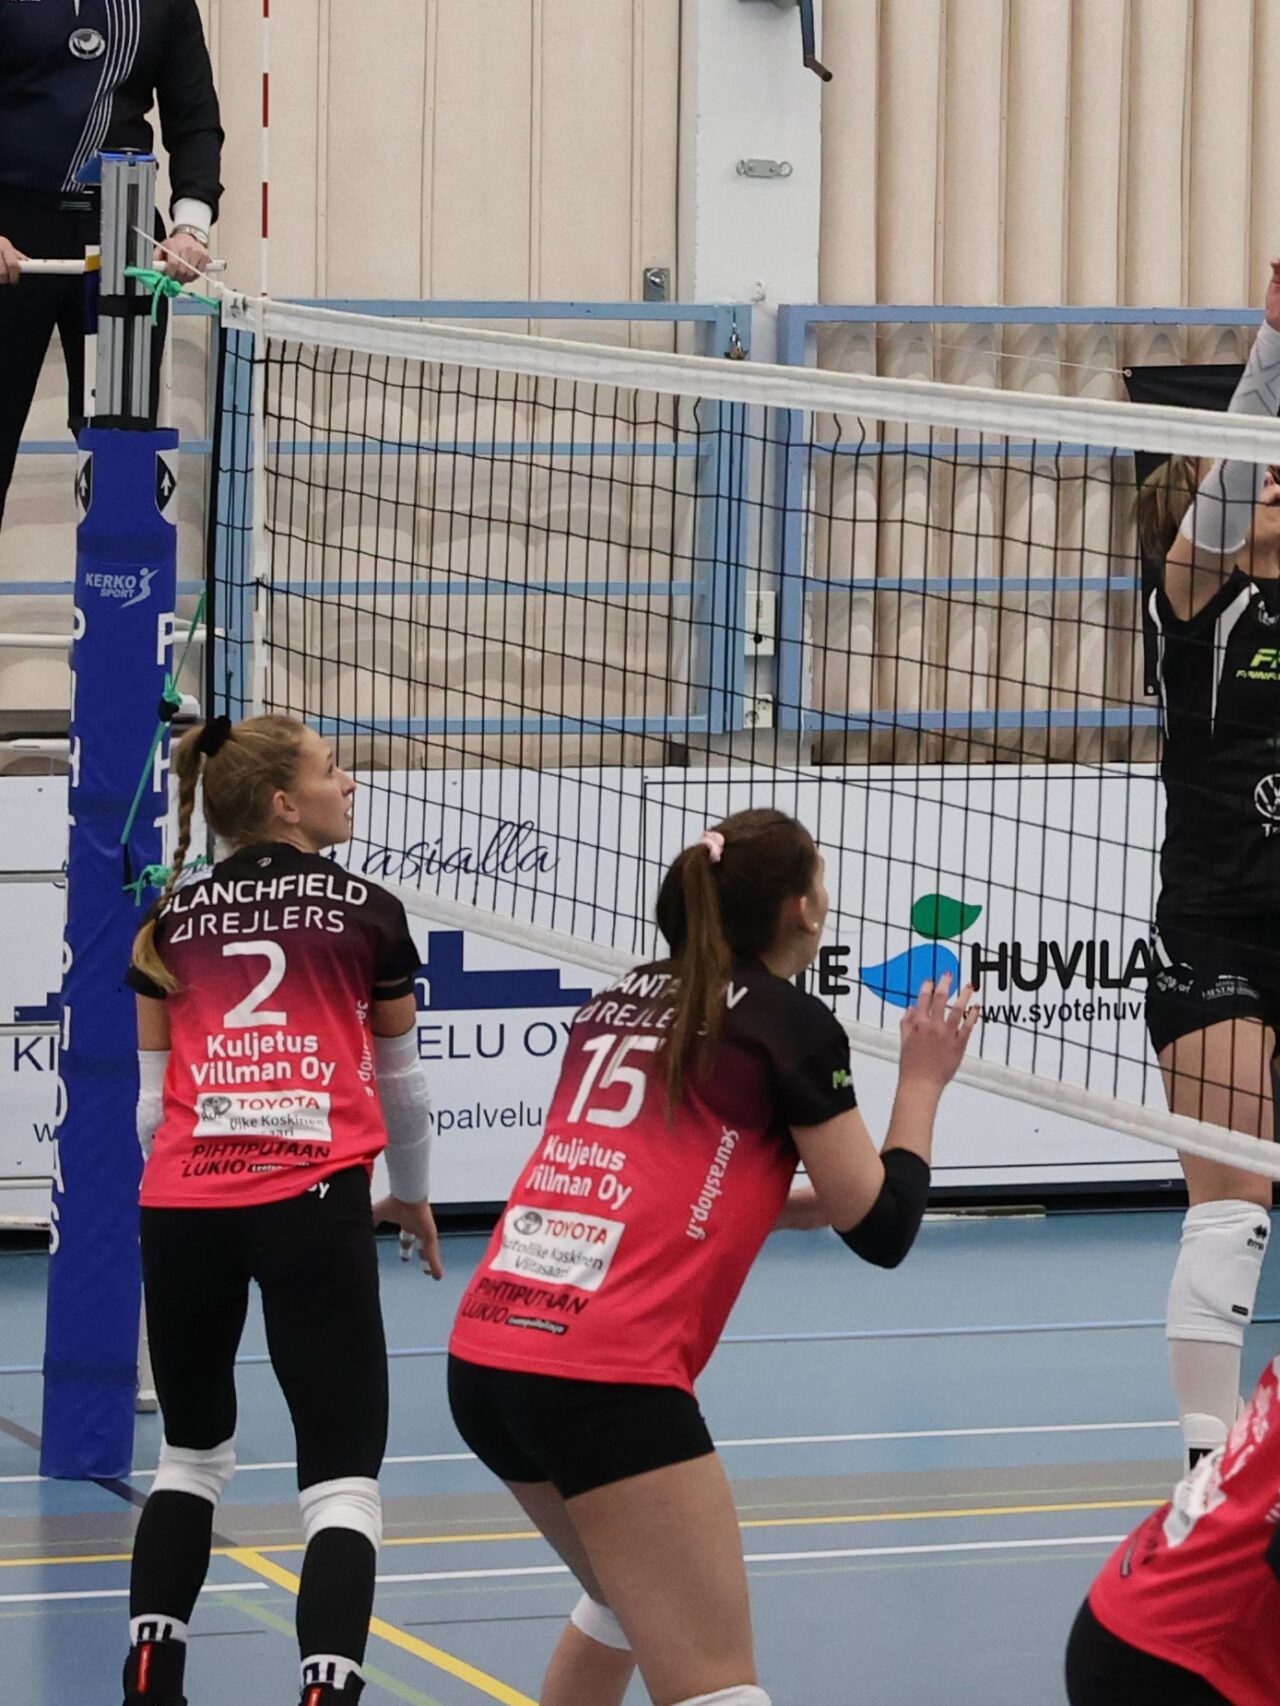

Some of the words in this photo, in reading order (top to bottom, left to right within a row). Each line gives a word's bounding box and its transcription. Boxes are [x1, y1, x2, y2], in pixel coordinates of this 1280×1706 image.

[85, 572, 137, 589] KERKO
[100, 587, 135, 598] SPORT
[361, 820, 562, 879] asialla
[200, 905, 345, 937] REJLERS
[222, 939, 287, 1029] 2
[206, 1030, 319, 1061] Kuljetus
[417, 1023, 504, 1060] ELU
[190, 1060, 292, 1086] Villman
[301, 1057, 336, 1086] Oy
[566, 1033, 667, 1128] 15
[237, 1096, 320, 1111] TOYOTA
[429, 1101, 542, 1136] palvelu
[542, 1135, 627, 1171] Kuljetus
[597, 1173, 633, 1211] Oy
[545, 1217, 609, 1246] TOYOTA
